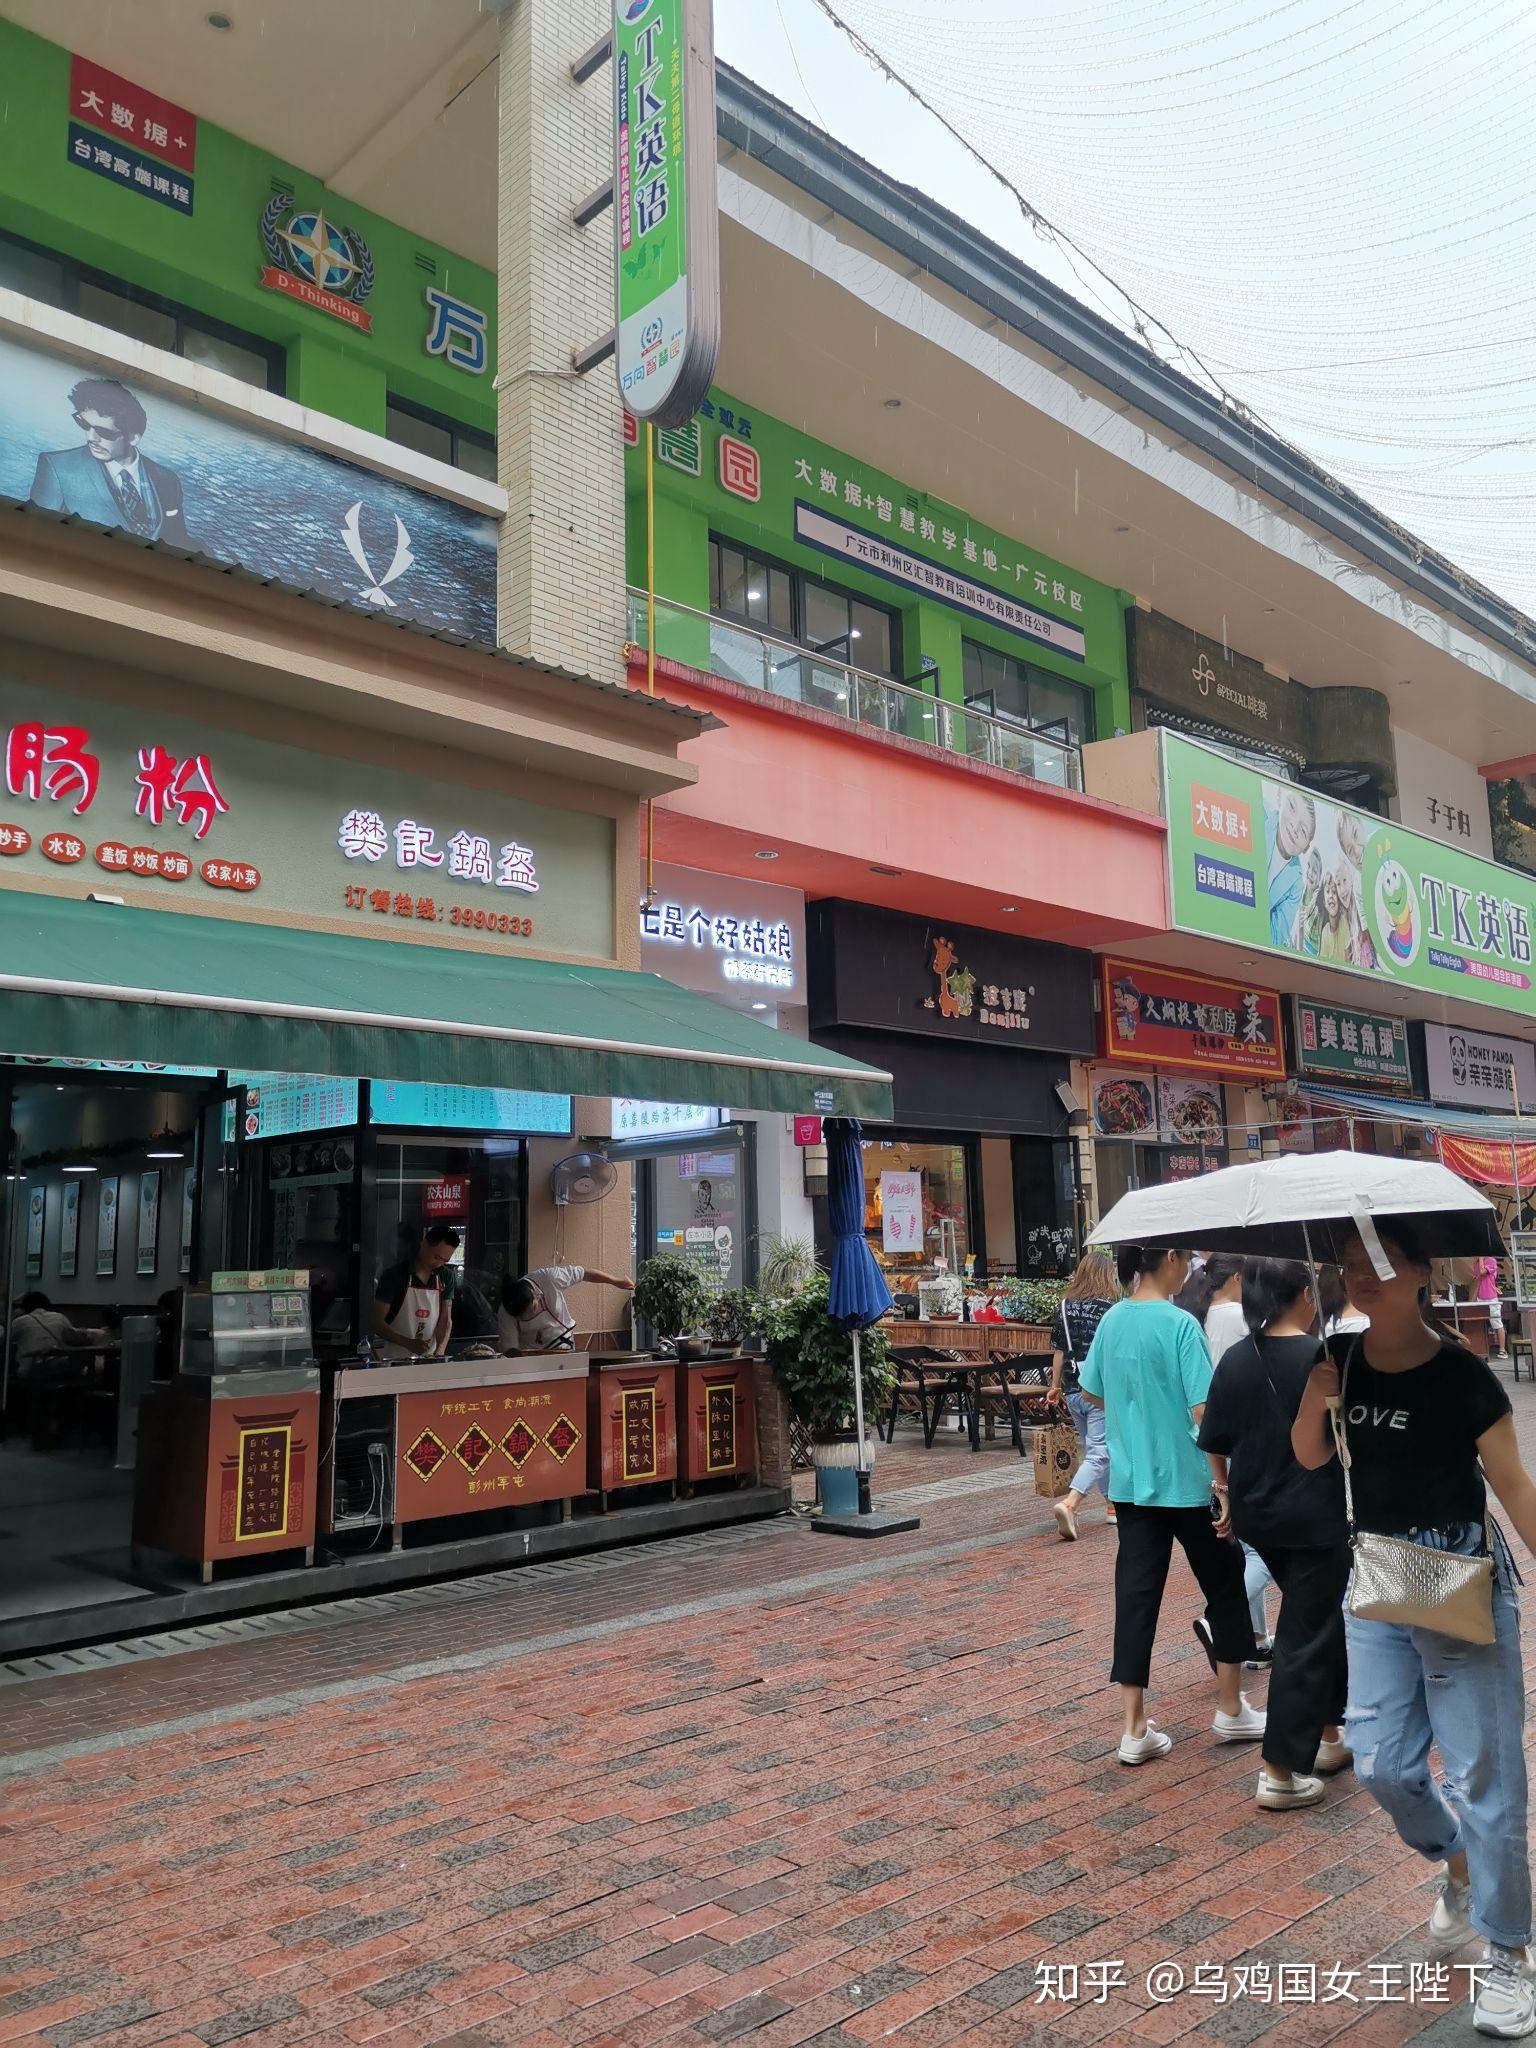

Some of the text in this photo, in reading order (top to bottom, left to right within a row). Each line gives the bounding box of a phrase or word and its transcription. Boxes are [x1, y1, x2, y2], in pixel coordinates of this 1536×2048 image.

[80, 89, 188, 149] 大数据+
[634, 16, 669, 238] TK英语
[74, 138, 190, 206] 台湾高端课程
[426, 285, 489, 375] 万
[845, 534, 1052, 637] 广元市利州区汇智教育培训中心有限责任公司
[6, 721, 230, 840] 肠粉
[1196, 800, 1249, 838] 大数据+
[48, 838, 81, 858] 水饺
[206, 864, 257, 886] 农家小菜
[1197, 863, 1254, 898] 台湾高端课程
[1420, 872, 1532, 965] TK英语
[1467, 1045, 1515, 1065] HONEY PANDA
[427, 1184, 461, 1200] 农夫山泉
[1336, 1405, 1410, 1430] OVE
[467, 1475, 526, 1495] 彭州军屯
